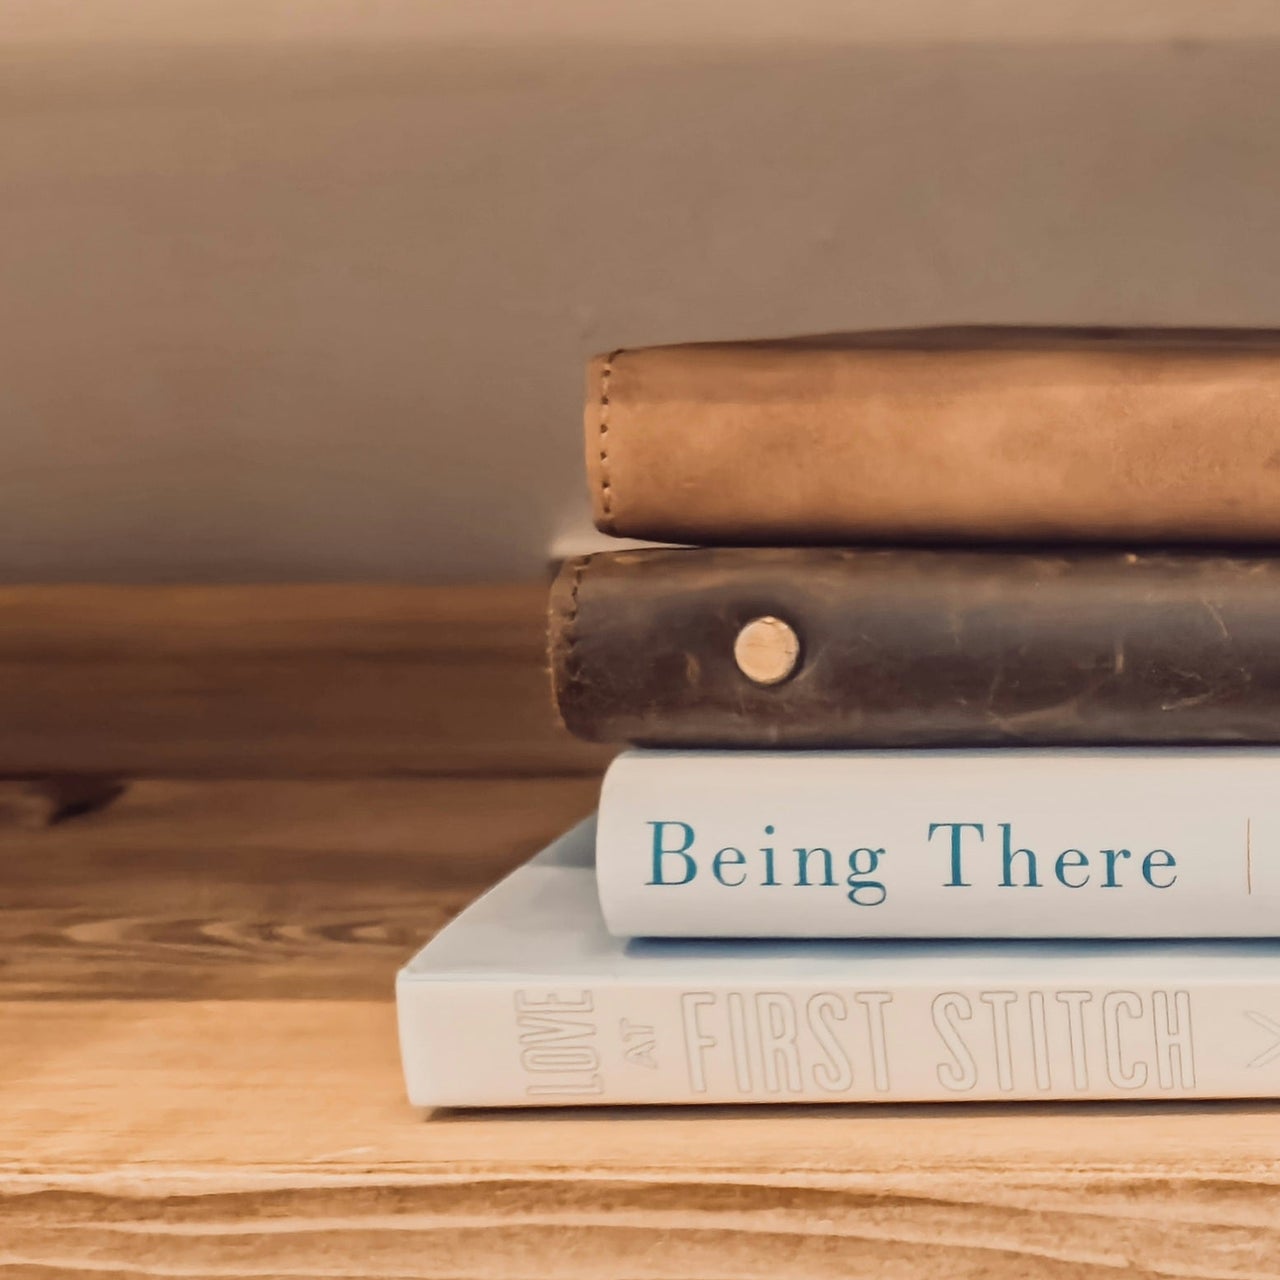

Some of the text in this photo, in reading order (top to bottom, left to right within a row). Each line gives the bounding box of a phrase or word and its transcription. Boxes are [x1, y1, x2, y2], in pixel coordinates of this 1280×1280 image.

[644, 820, 1178, 906] Being There
[515, 989, 604, 1095] LOVE
[620, 1018, 658, 1070] AT
[680, 991, 894, 1094] FIRST
[930, 991, 1196, 1092] STITCH
